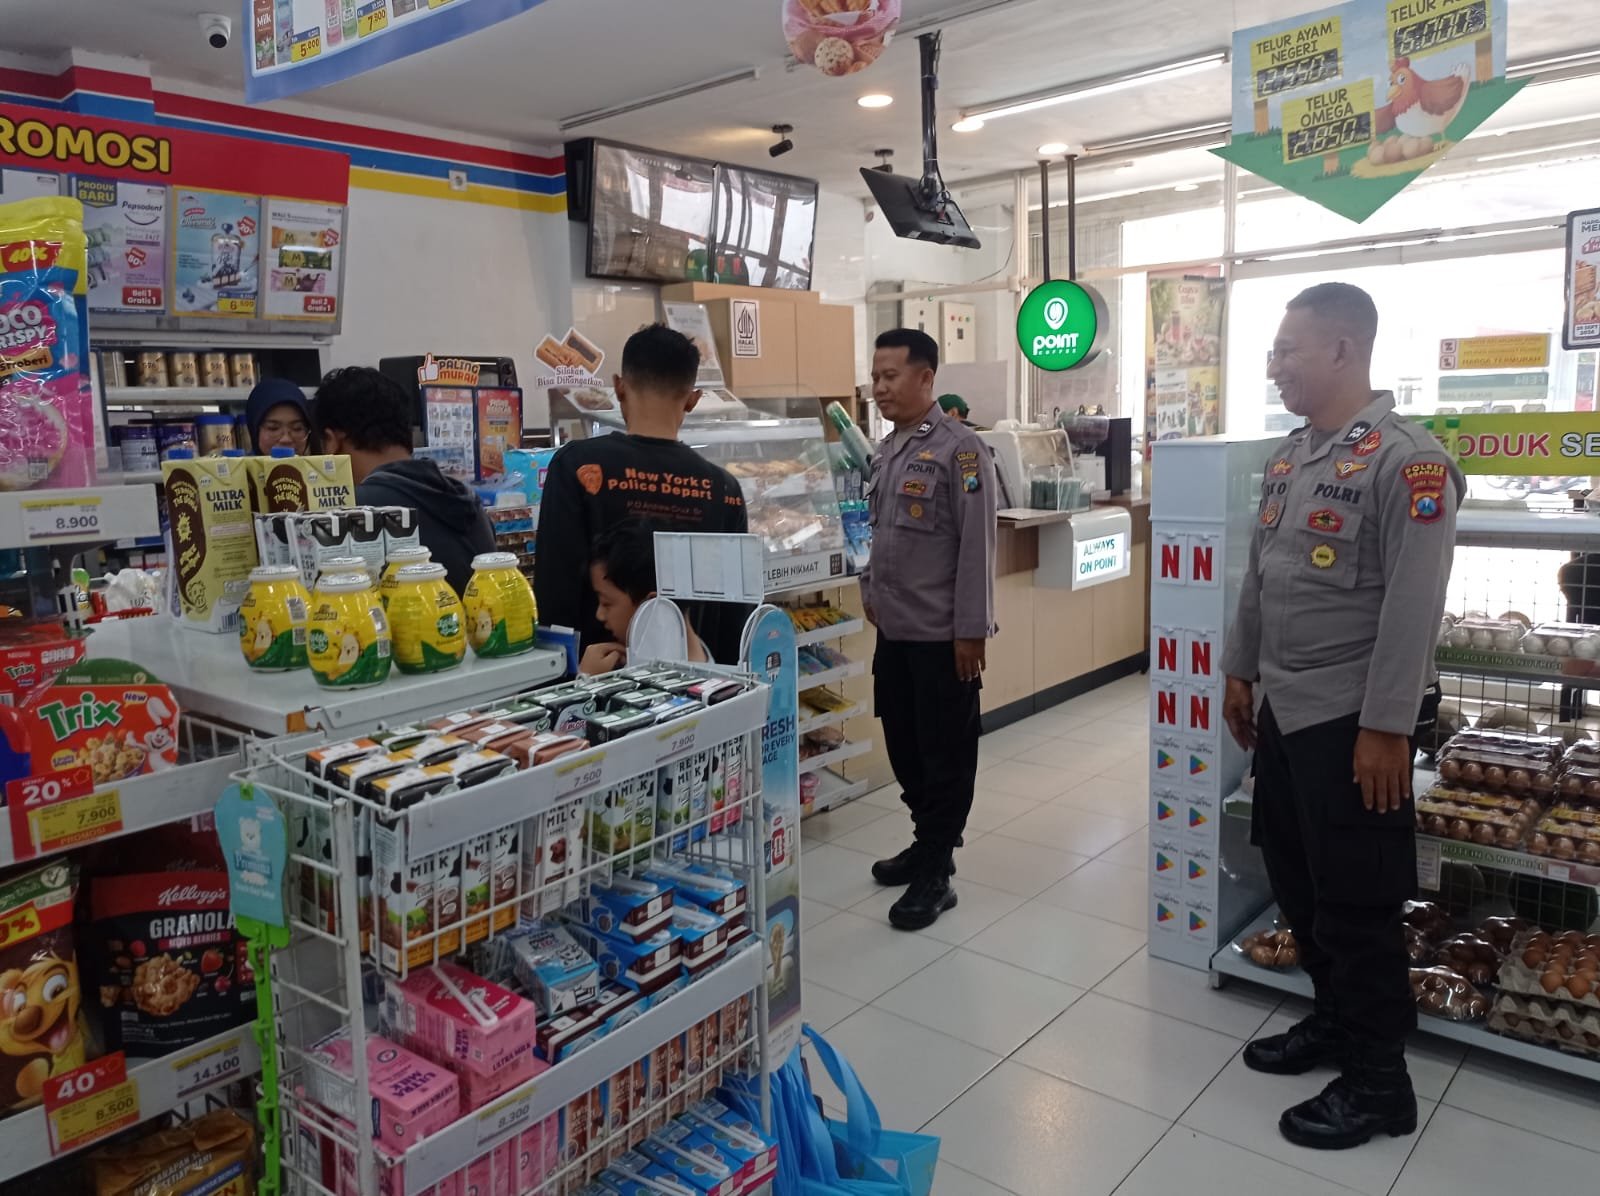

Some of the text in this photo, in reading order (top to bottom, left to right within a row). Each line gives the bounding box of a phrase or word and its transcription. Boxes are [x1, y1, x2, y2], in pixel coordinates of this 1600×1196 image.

[256, 12, 272, 28] Milk
[1391, 0, 1436, 23] TELUR
[1256, 21, 1333, 55] TELUR AYAM
[1271, 40, 1319, 65] NEGERI
[1305, 88, 1348, 112] TELUR
[1300, 102, 1354, 128] OMEGA
[78, 180, 115, 191] PRODUK
[79, 189, 115, 202] BARU
[121, 201, 163, 212] Pepsodent
[127, 296, 151, 306] Gratis
[132, 287, 147, 297] Beli
[439, 359, 479, 374] PALING
[439, 370, 479, 385] MURAH
[624, 467, 712, 489] New York C
[906, 463, 936, 475] POLRI
[205, 488, 246, 502] ULTRA
[312, 485, 350, 498] ULTRA
[607, 478, 657, 494] Police
[1313, 482, 1362, 505] POLRI
[213, 500, 242, 513] MILK
[318, 496, 346, 508] MILK
[55, 514, 98, 530] 8.900
[1083, 538, 1115, 557] ALWAYS
[767, 560, 820, 581] LEBIH NIKMAT
[1079, 555, 1117, 575] ON POINT
[1161, 544, 1180, 579] N
[1192, 546, 1213, 582] N
[1158, 637, 1177, 672] N
[1191, 641, 1211, 676] N
[3, 662, 37, 681] Trix
[37, 690, 124, 742] Trix
[1157, 691, 1176, 726] N
[1190, 695, 1210, 731] N
[671, 733, 695, 751] 7.900
[770, 732, 796, 752] EVERY
[762, 753, 778, 766] AGE
[573, 768, 602, 788] 7.500
[77, 805, 116, 825] 7.900
[157, 883, 227, 907] Kellogg's
[149, 911, 237, 940] GRANOLA
[193, 1055, 240, 1084] 14.100
[96, 1097, 134, 1121] 8.500
